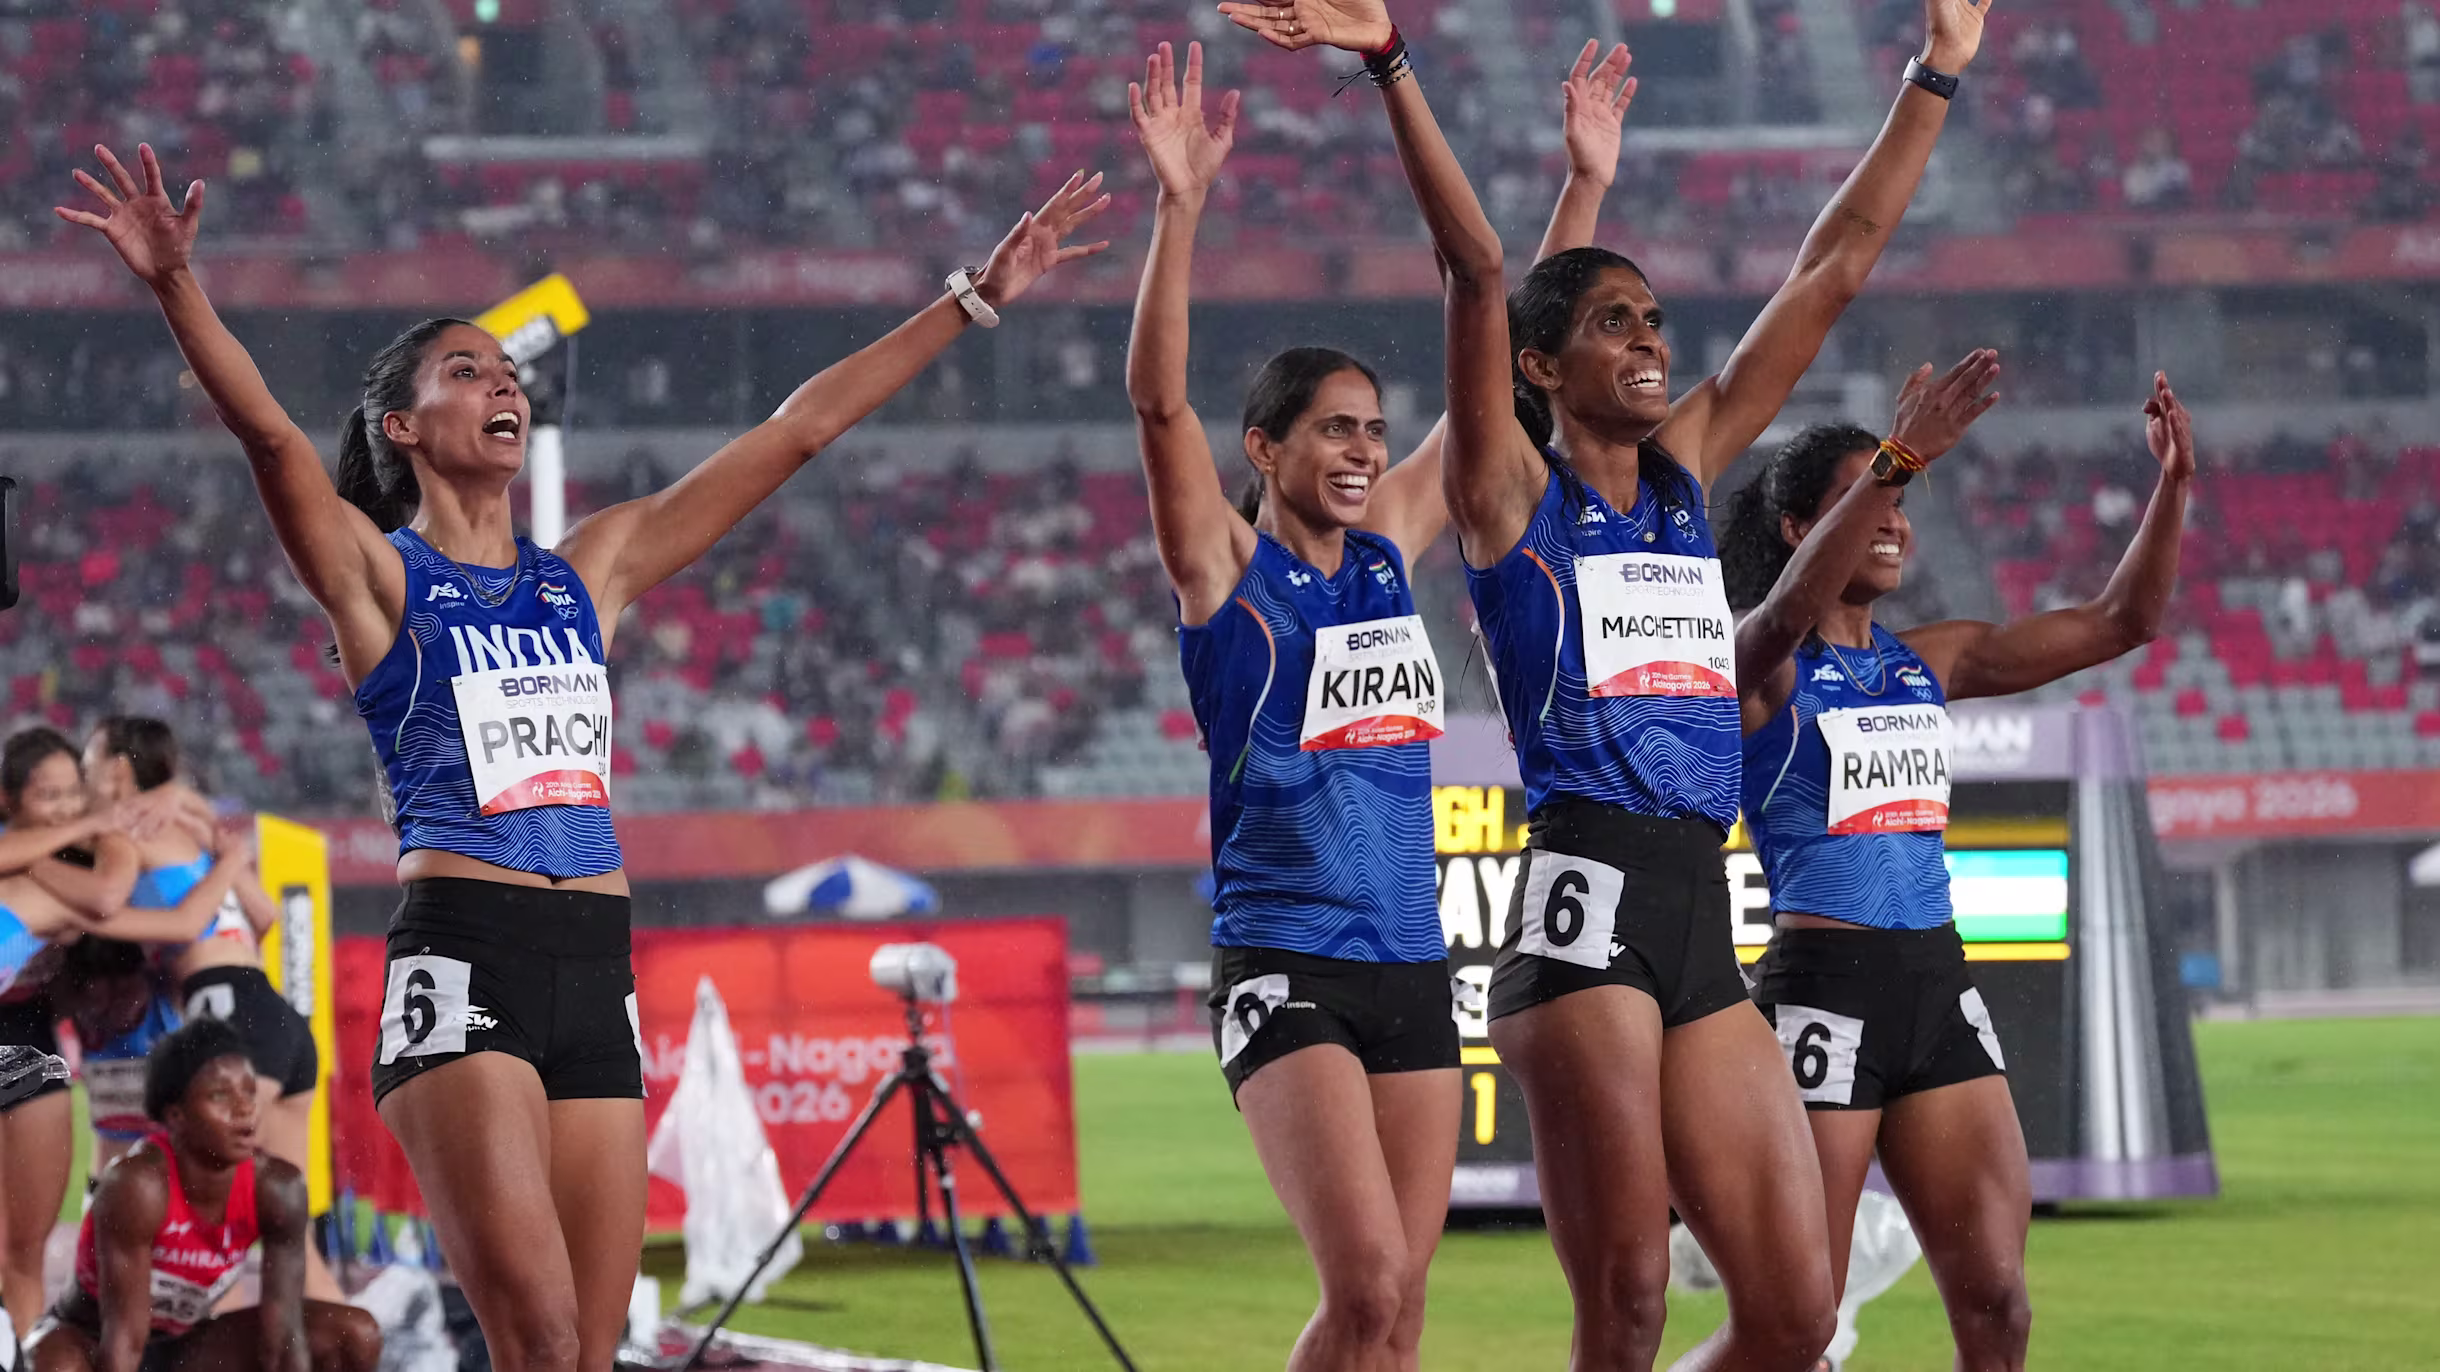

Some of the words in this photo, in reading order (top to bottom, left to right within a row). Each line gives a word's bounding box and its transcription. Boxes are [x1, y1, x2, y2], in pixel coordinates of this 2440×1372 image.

[1618, 563, 1704, 585] BORNAN
[1346, 626, 1412, 652] BORNAN
[1602, 615, 1725, 641] MACHETTIRA
[1708, 656, 1730, 670] 1043
[498, 673, 598, 697] BORNAN
[1320, 658, 1435, 709] KIRAN
[1693, 681, 1711, 690] 2026
[505, 697, 544, 710] SPORTS
[1856, 713, 1939, 733] BORNAN
[478, 713, 608, 765] PRACHI
[1544, 869, 1590, 948] 6
[402, 968, 437, 1044] 6
[1792, 1021, 1832, 1090] 6
